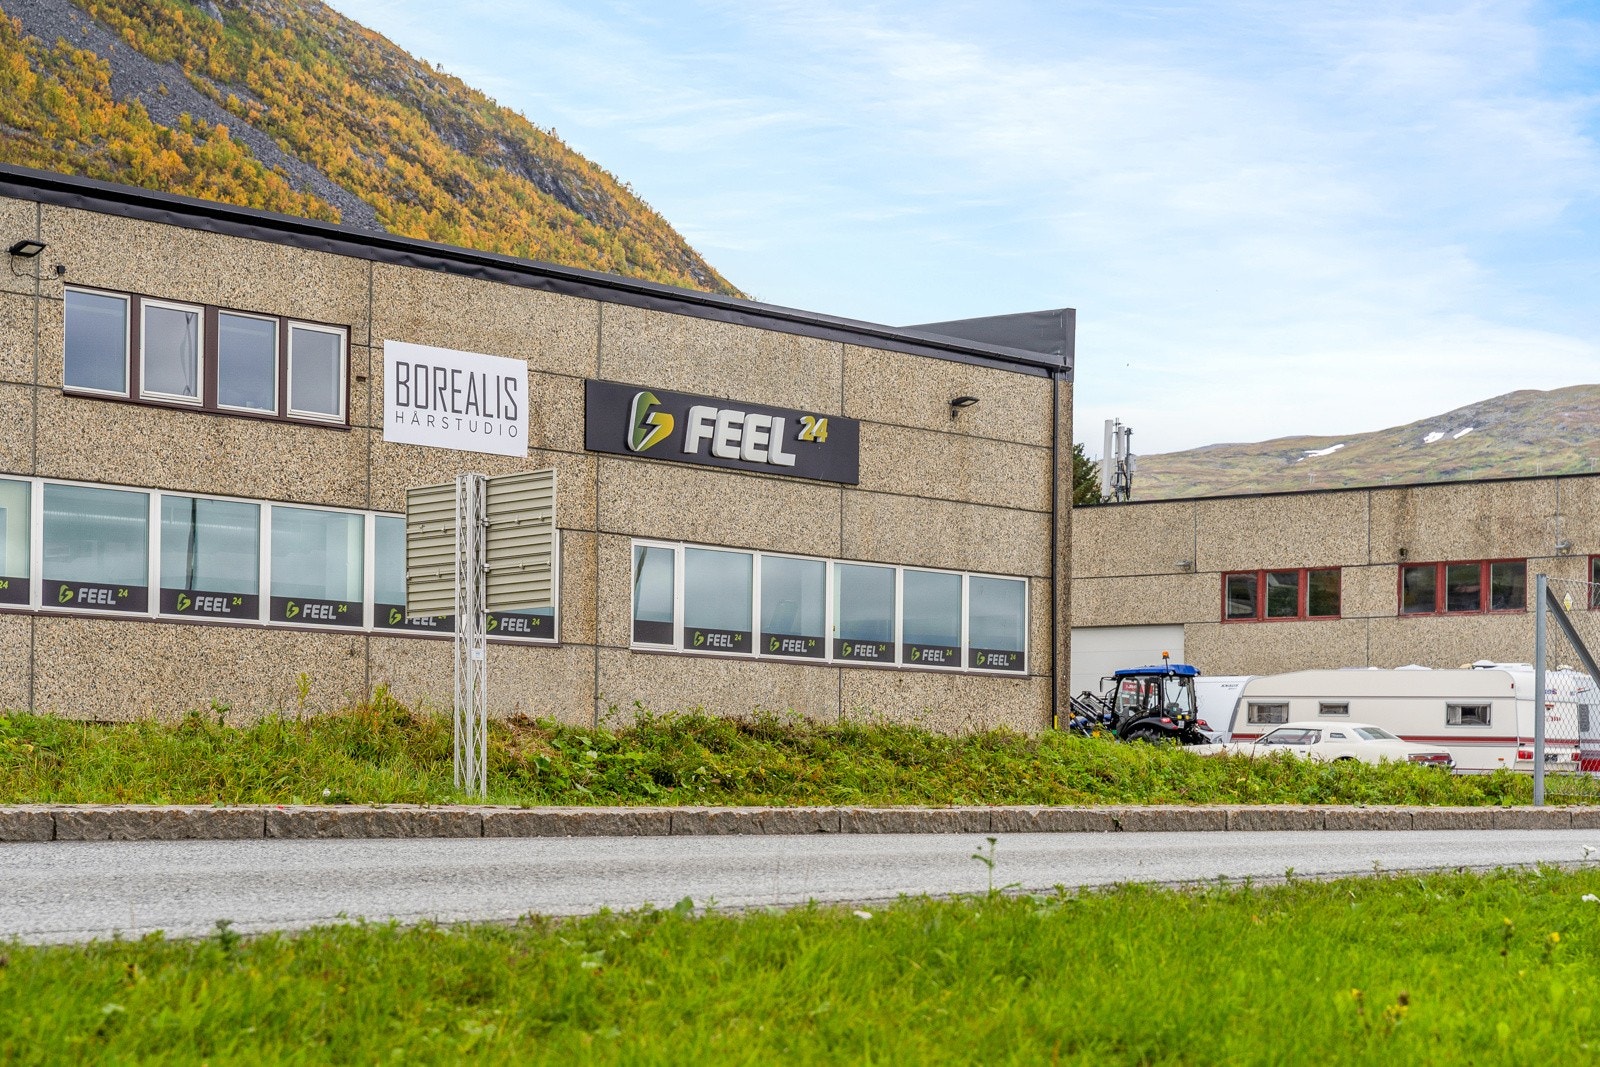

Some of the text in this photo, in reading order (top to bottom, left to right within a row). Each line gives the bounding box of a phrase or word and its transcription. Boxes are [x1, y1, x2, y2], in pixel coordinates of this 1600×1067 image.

[396, 361, 518, 421] BOREALIS
[395, 411, 518, 437] HÅRSTUDIO
[684, 405, 828, 467] FEEL 24
[77, 587, 129, 605] FEEL 24
[194, 596, 242, 613] FEEL 24
[302, 603, 348, 620] FEEL 24
[500, 617, 541, 633] FEEL 24
[706, 633, 742, 648] FEEL 24
[782, 639, 808, 653] FEEL
[853, 644, 878, 658] FEEL
[922, 649, 946, 662] FEEL
[987, 653, 1010, 667] FEEL
